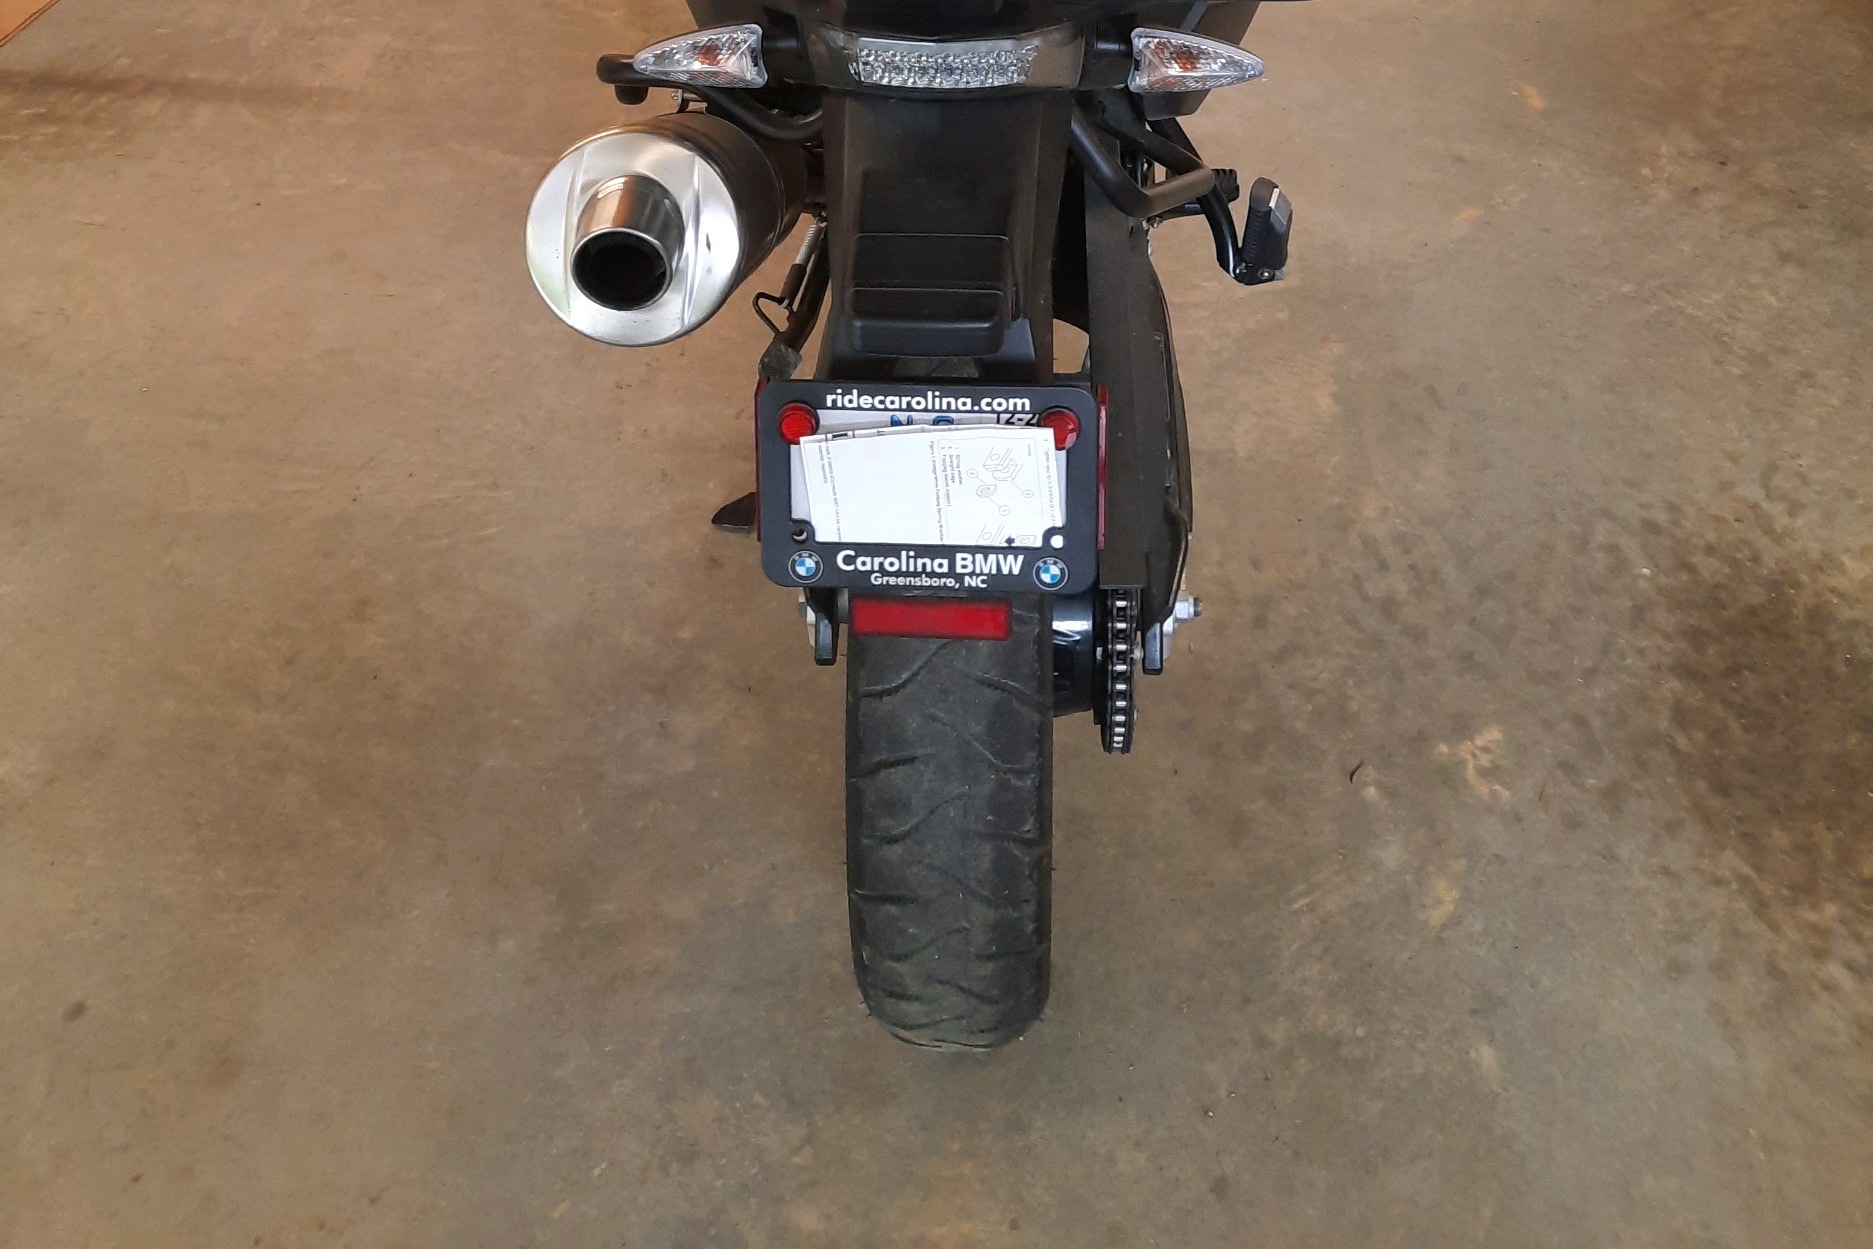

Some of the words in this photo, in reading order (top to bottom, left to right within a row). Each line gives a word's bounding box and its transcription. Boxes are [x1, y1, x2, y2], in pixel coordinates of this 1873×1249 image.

[826, 388, 1031, 412] ridecarolina.com
[836, 549, 949, 574] Carolina
[955, 552, 1025, 576] BMW
[870, 572, 961, 590] Greensboro,
[964, 575, 988, 589] NC
